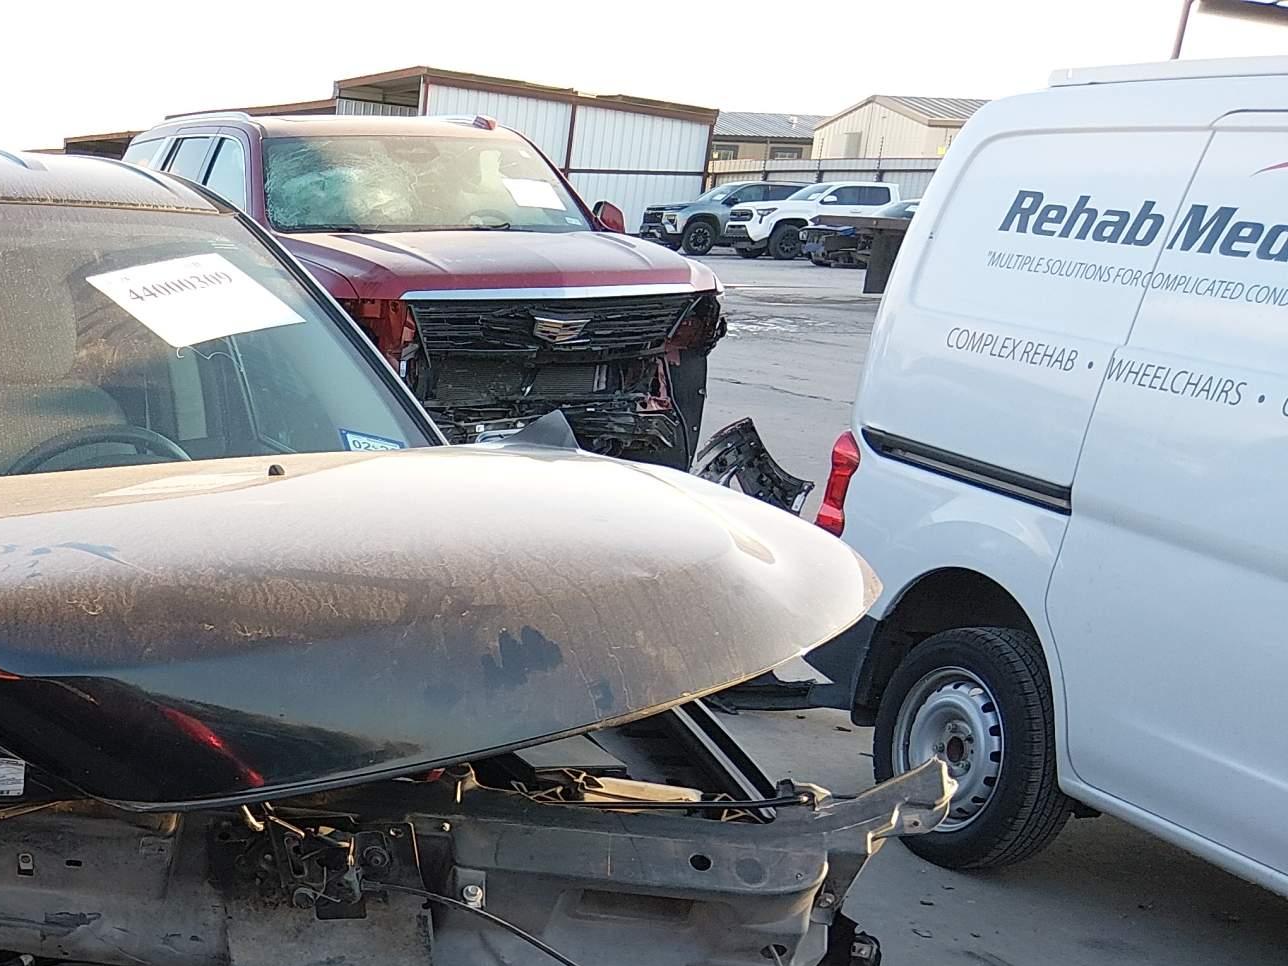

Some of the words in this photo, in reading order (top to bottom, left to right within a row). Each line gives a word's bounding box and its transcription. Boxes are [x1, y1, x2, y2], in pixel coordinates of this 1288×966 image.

[998, 189, 1165, 247] Rehab
[127, 271, 233, 302] 44000309
[1043, 258, 1114, 283] SOLUTIONS
[1112, 267, 1143, 287] FOR
[1141, 271, 1245, 300] COMPLICATED
[946, 327, 1023, 361] COMPLEX
[1019, 341, 1079, 372] REHAB
[1107, 357, 1248, 406] WHEELCHAIRS
